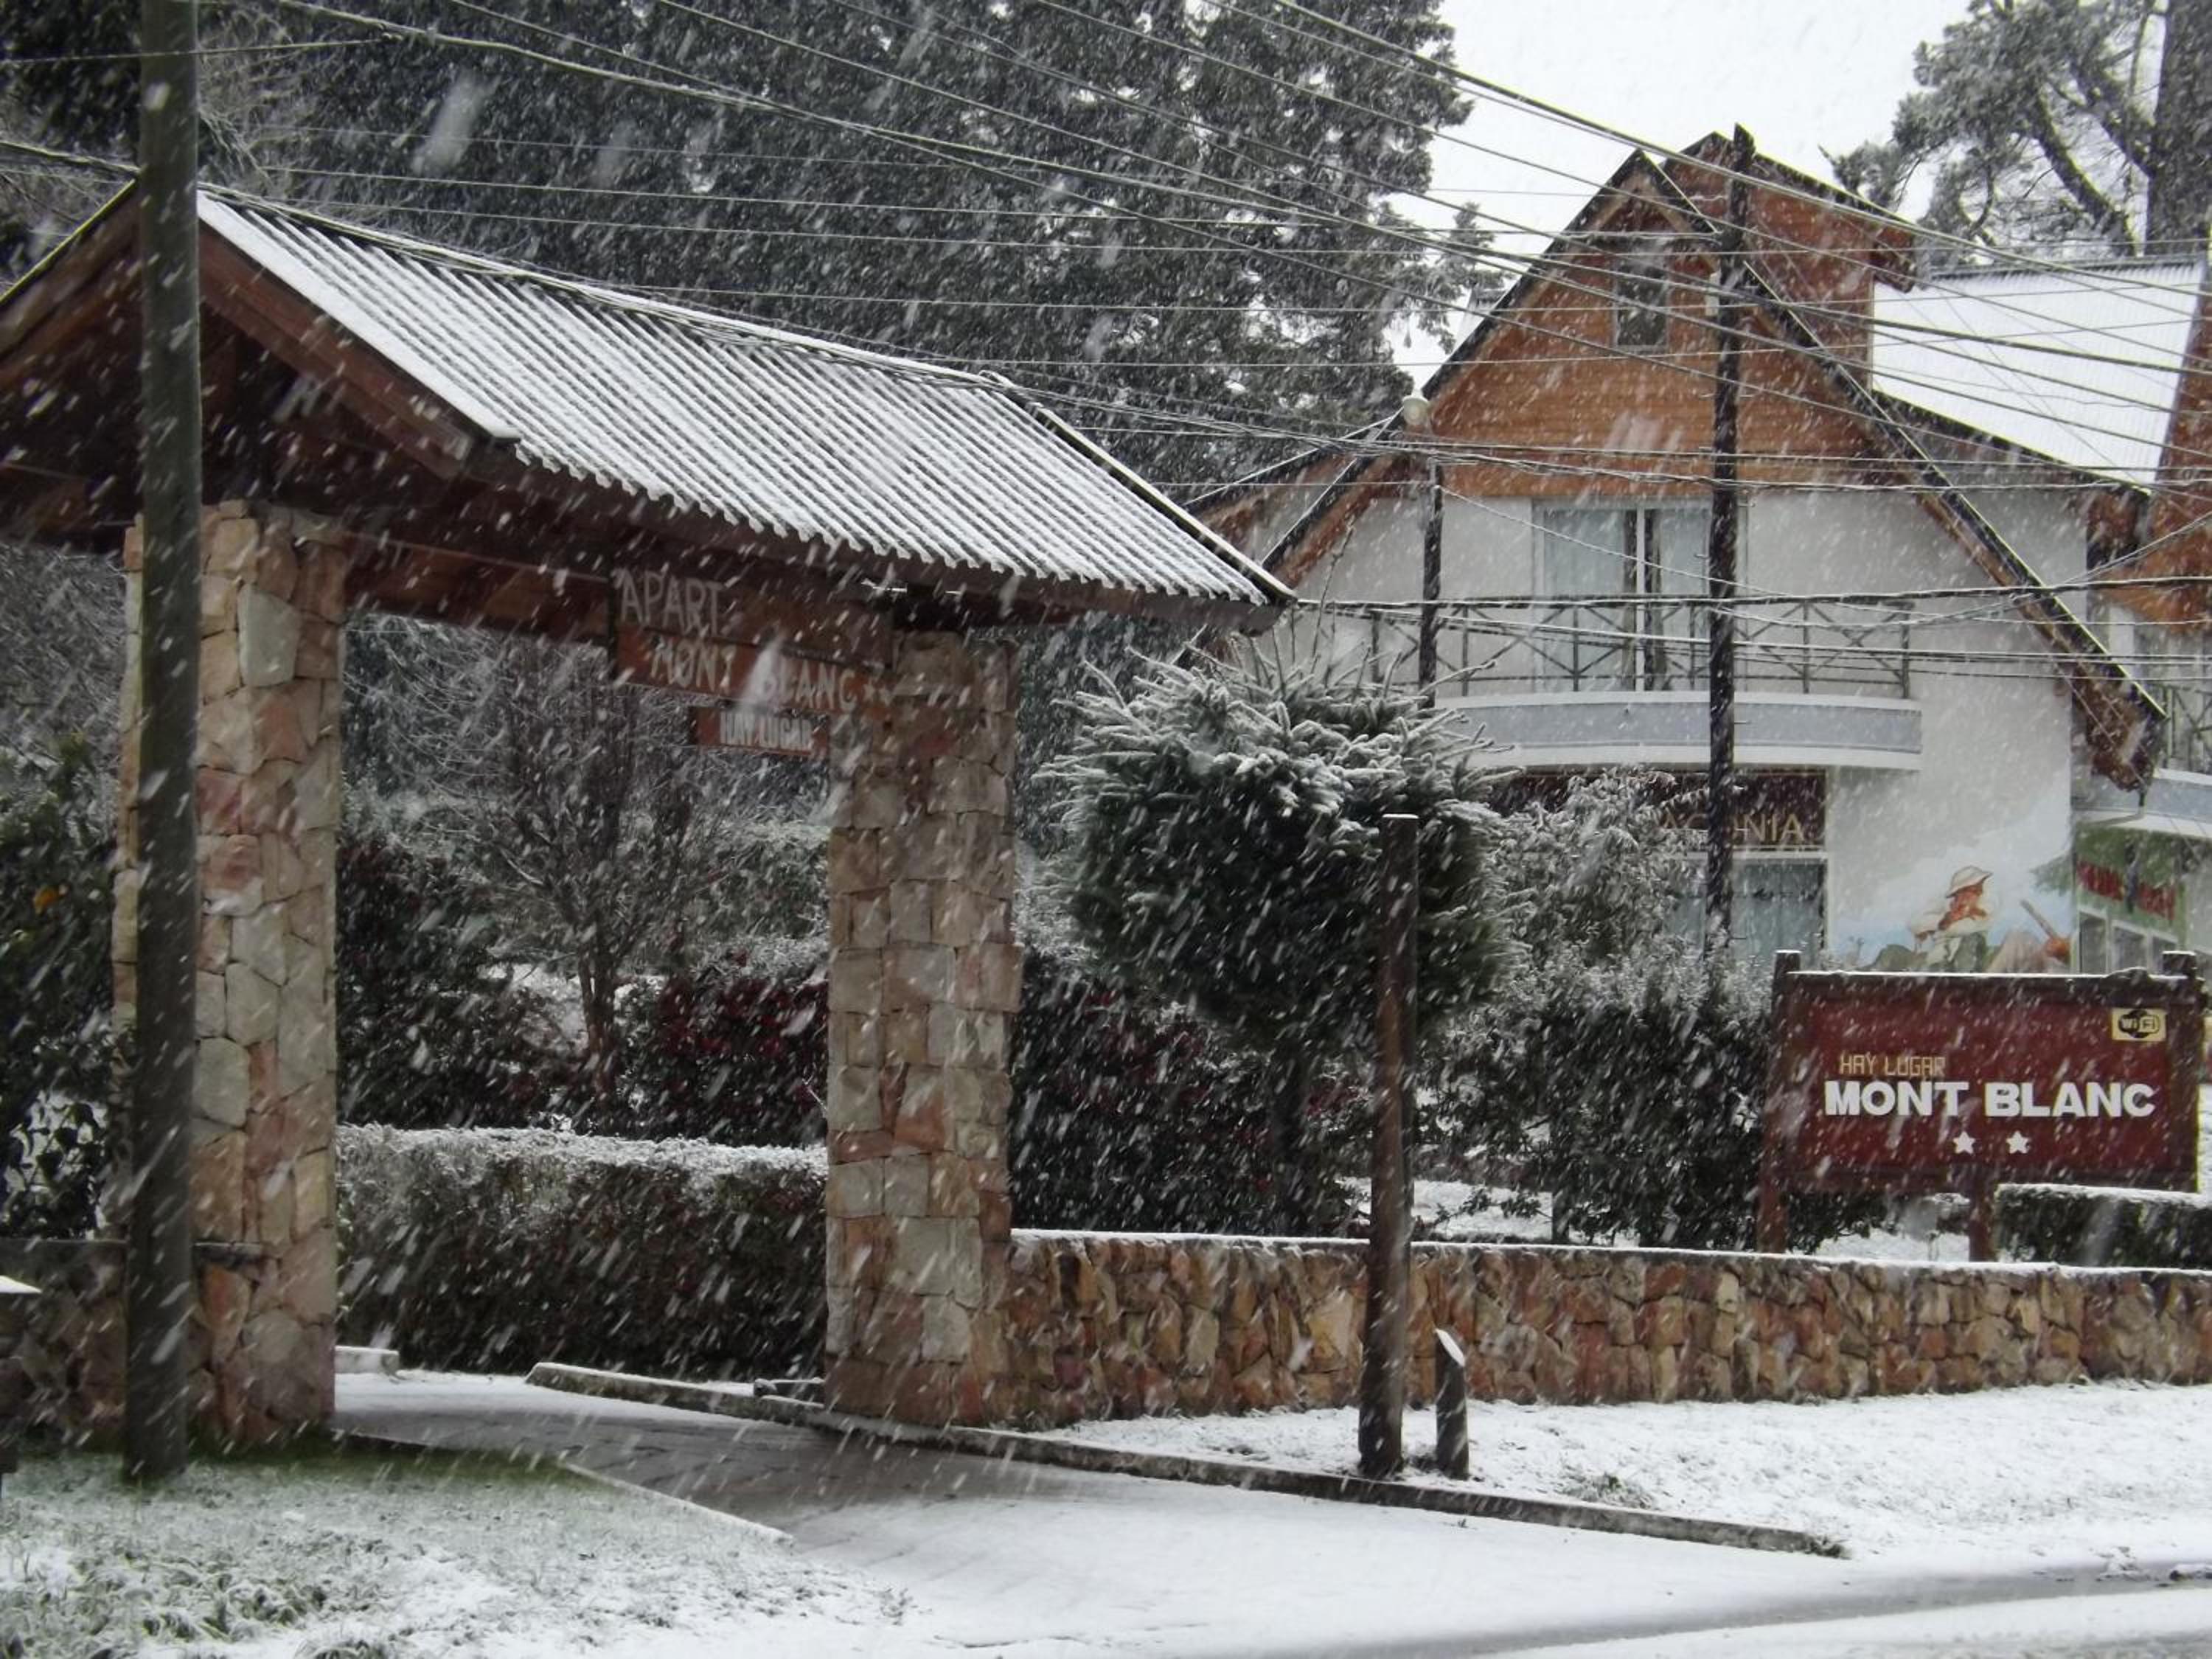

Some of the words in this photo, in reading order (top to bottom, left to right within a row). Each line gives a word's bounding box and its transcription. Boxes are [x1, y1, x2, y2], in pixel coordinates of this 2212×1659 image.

[619, 568, 724, 636] APART
[1840, 1053, 1877, 1075] HAY
[1885, 1055, 1946, 1077] LUGAR
[1824, 1080, 1970, 1116] MONT
[1984, 1081, 2158, 1118] BLANC
